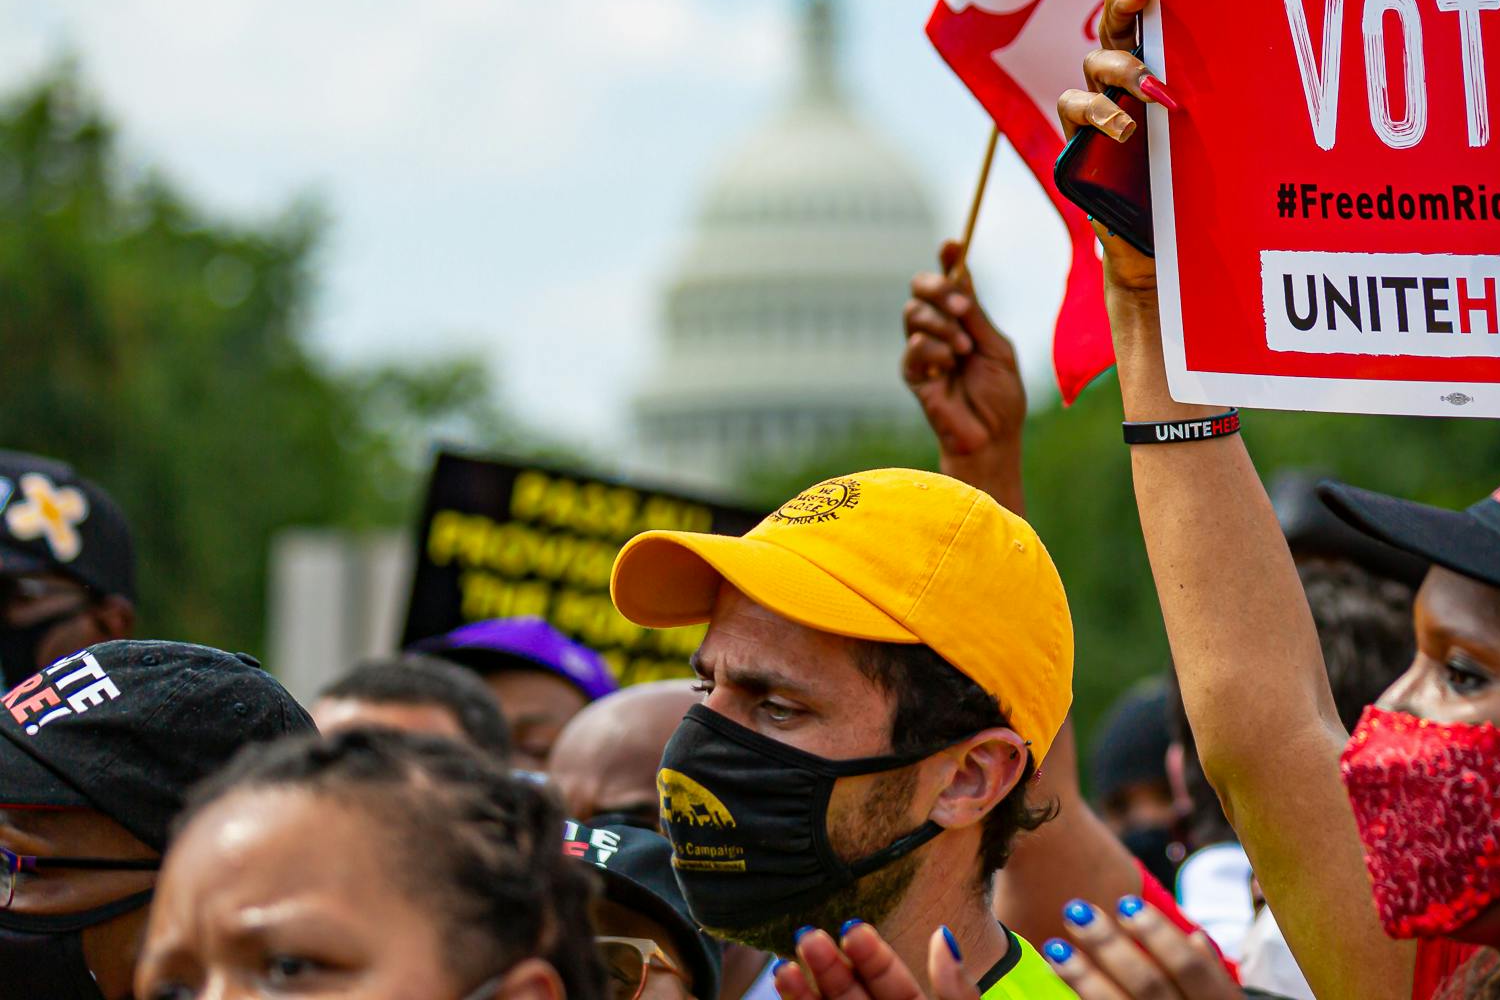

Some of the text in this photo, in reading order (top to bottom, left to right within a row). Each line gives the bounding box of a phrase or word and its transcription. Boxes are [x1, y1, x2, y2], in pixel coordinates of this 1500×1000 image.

[0, 673, 72, 736] RE!
[43, 649, 121, 714] ITE
[686, 842, 744, 858] Campaign
